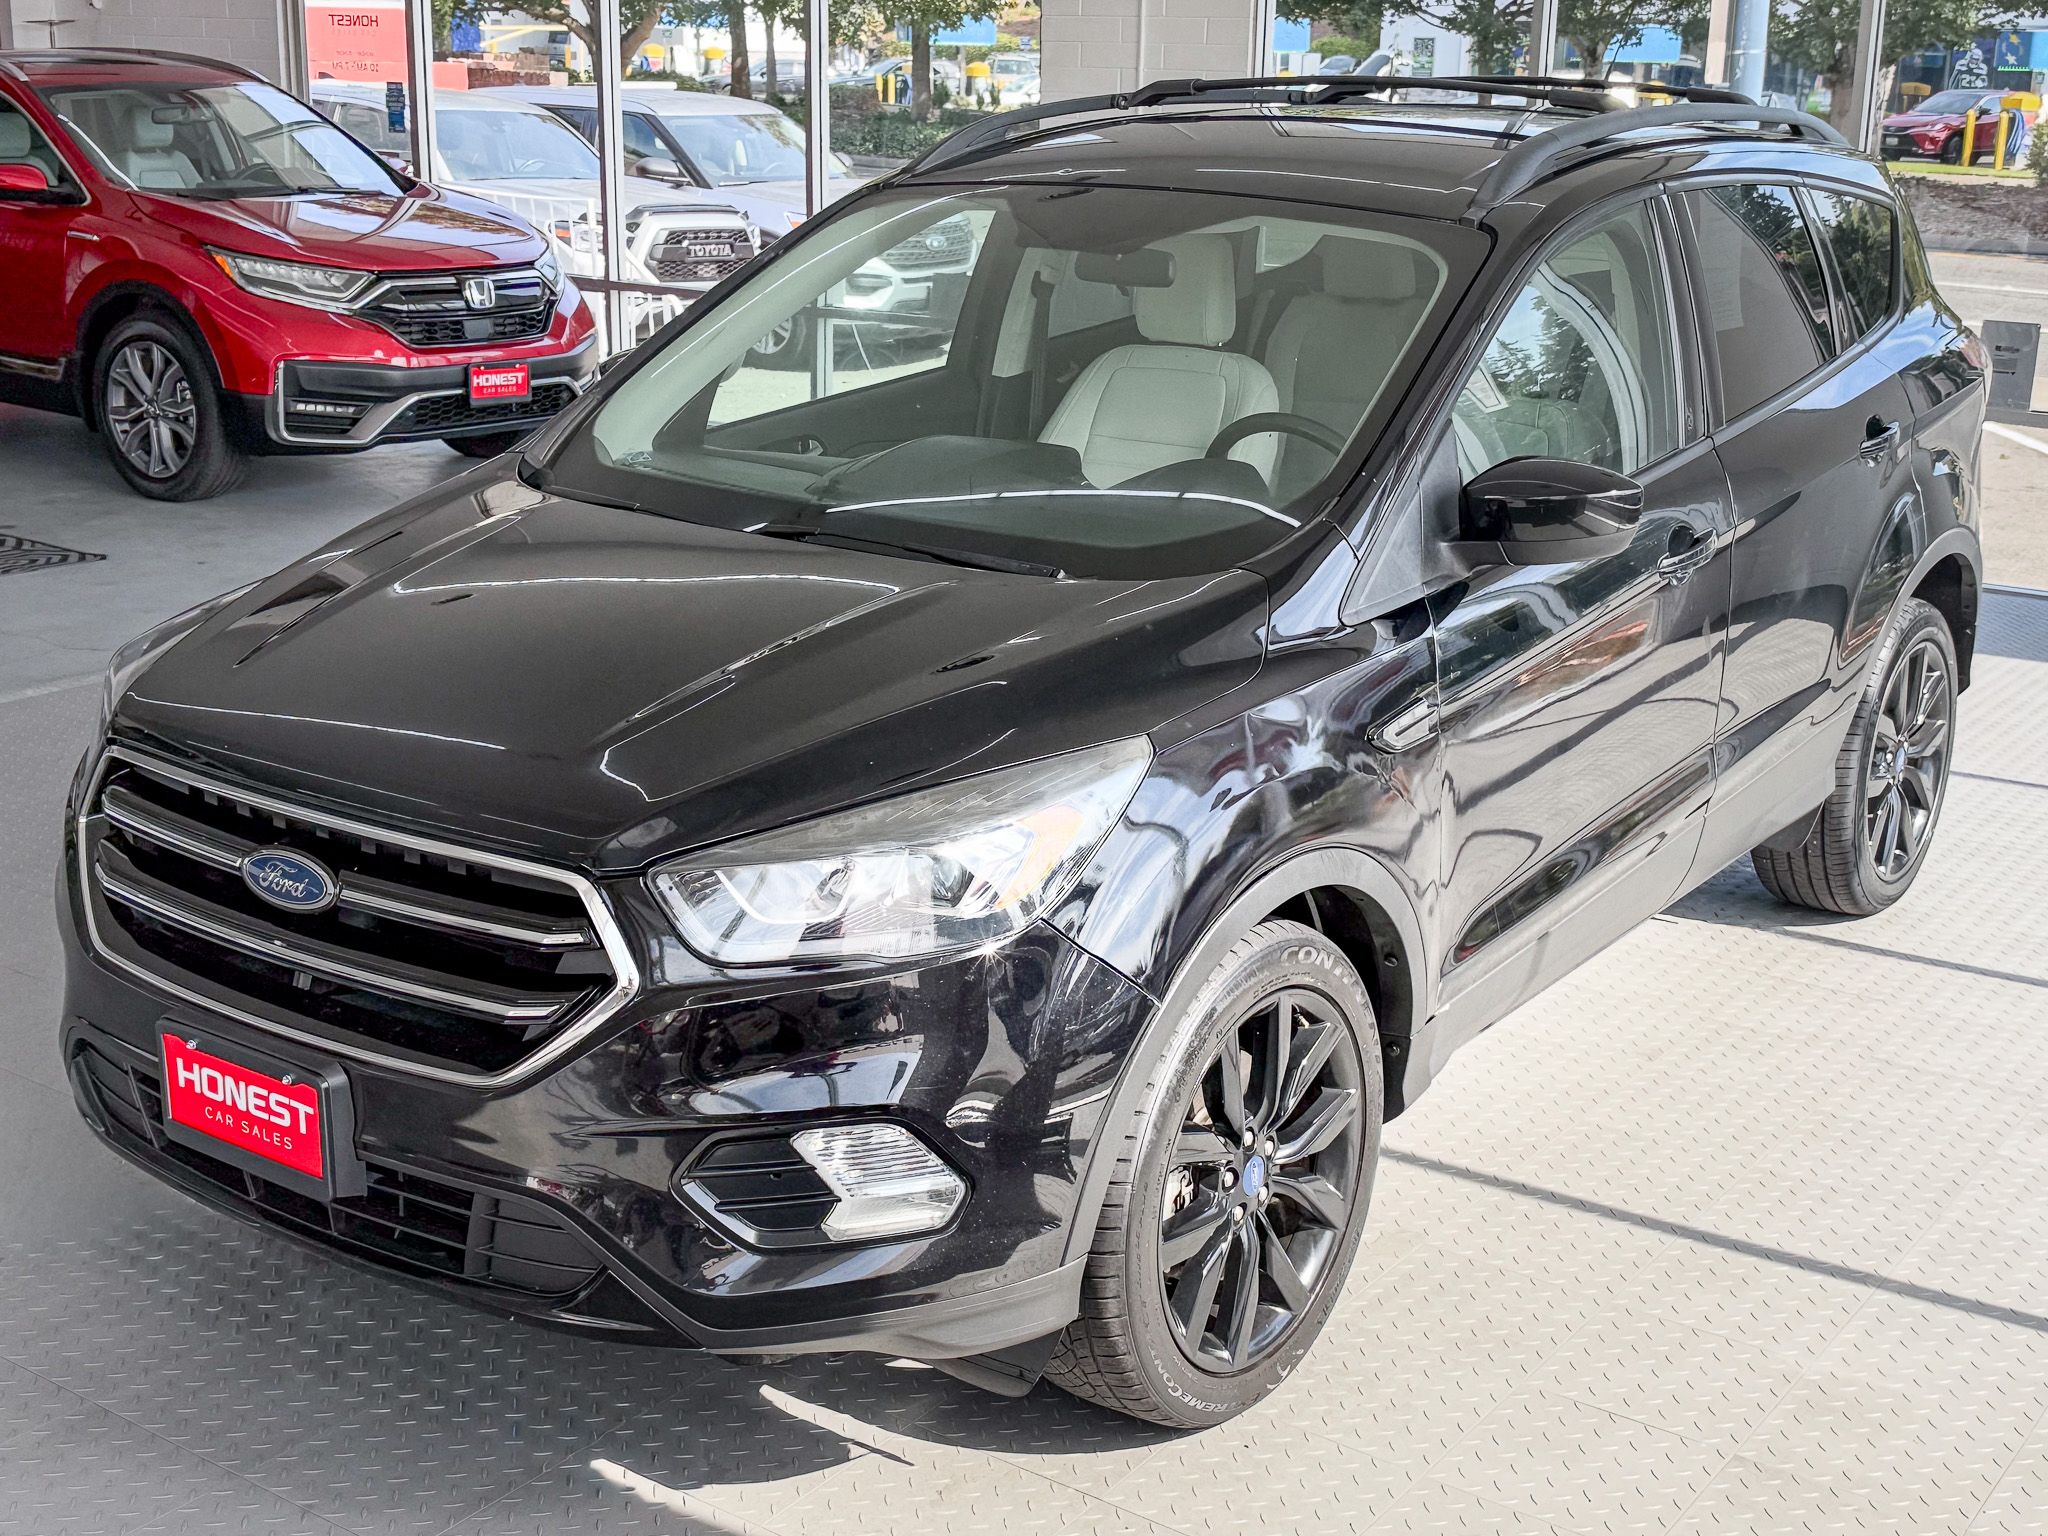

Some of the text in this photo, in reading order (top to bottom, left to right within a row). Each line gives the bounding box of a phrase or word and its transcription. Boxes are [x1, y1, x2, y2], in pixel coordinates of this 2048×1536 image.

[688, 244, 732, 257] TOYOTA
[473, 372, 525, 387] HONEST
[497, 385, 517, 393] SALES
[259, 861, 319, 898] Ford
[176, 1057, 314, 1135] HONEST
[205, 1106, 293, 1150] CAR SALES
